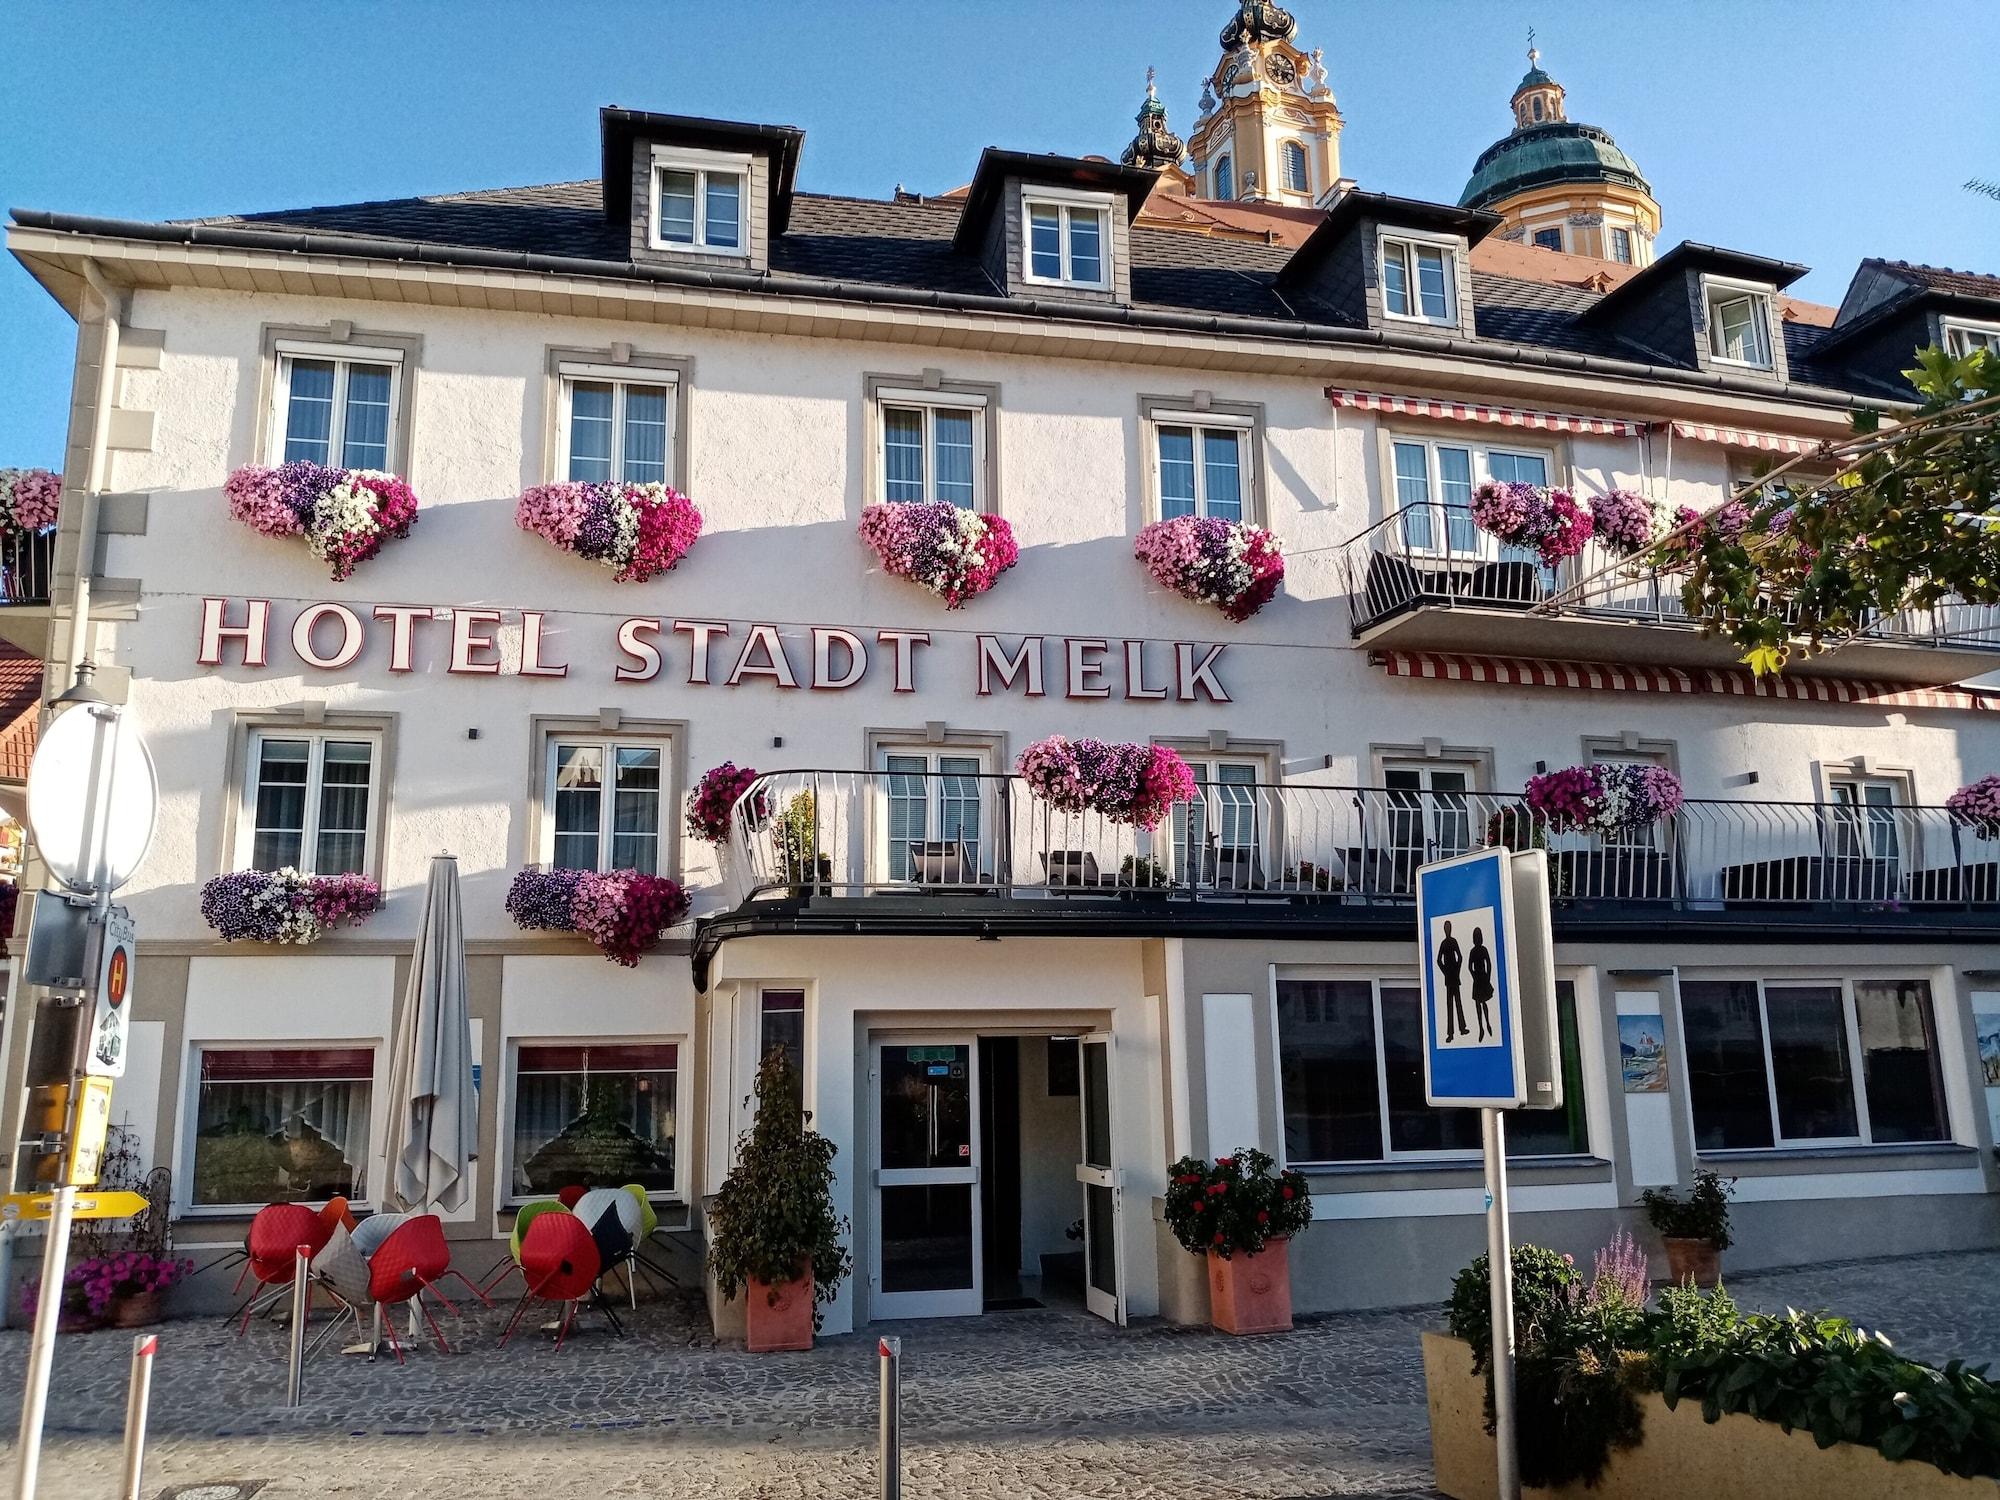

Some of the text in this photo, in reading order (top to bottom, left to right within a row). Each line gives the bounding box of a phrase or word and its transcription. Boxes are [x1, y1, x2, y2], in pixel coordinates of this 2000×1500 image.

[196, 597, 1233, 703] HOTEL STADT MELK
[112, 959, 123, 994] H
